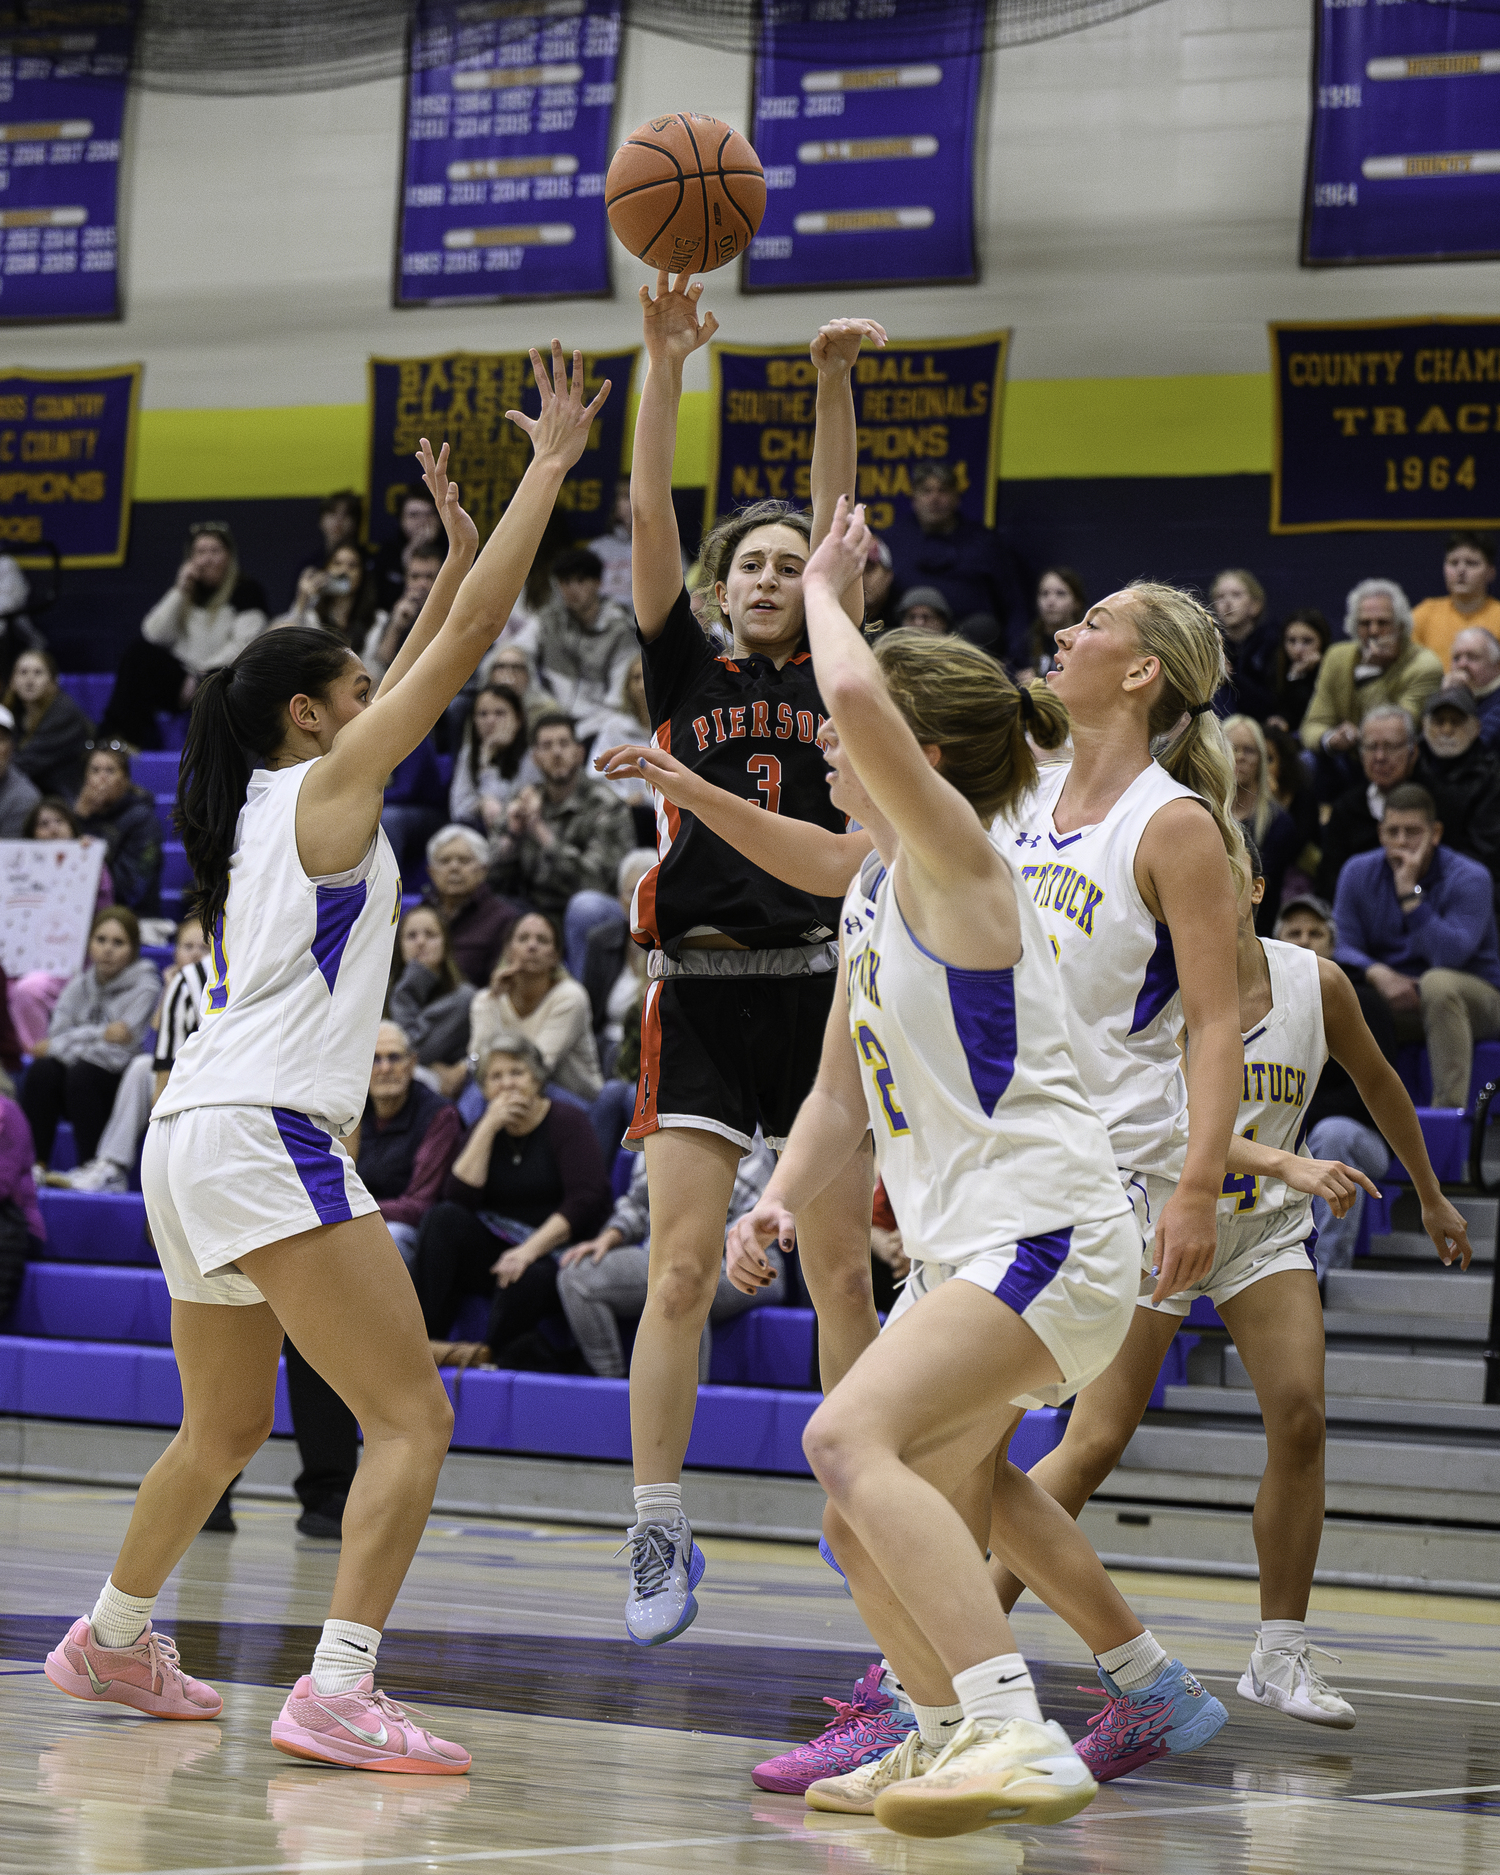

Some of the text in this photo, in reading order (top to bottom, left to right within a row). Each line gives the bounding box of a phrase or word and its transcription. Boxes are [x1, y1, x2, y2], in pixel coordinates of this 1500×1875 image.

[1288, 351, 1404, 387] COUNTY
[1332, 403, 1500, 438] TRAC
[21, 428, 99, 463] COUNTY
[1385, 454, 1477, 493] 1964
[746, 753, 782, 815] 3
[853, 1019, 912, 1138] 2
[1219, 1124, 1260, 1216] 4
